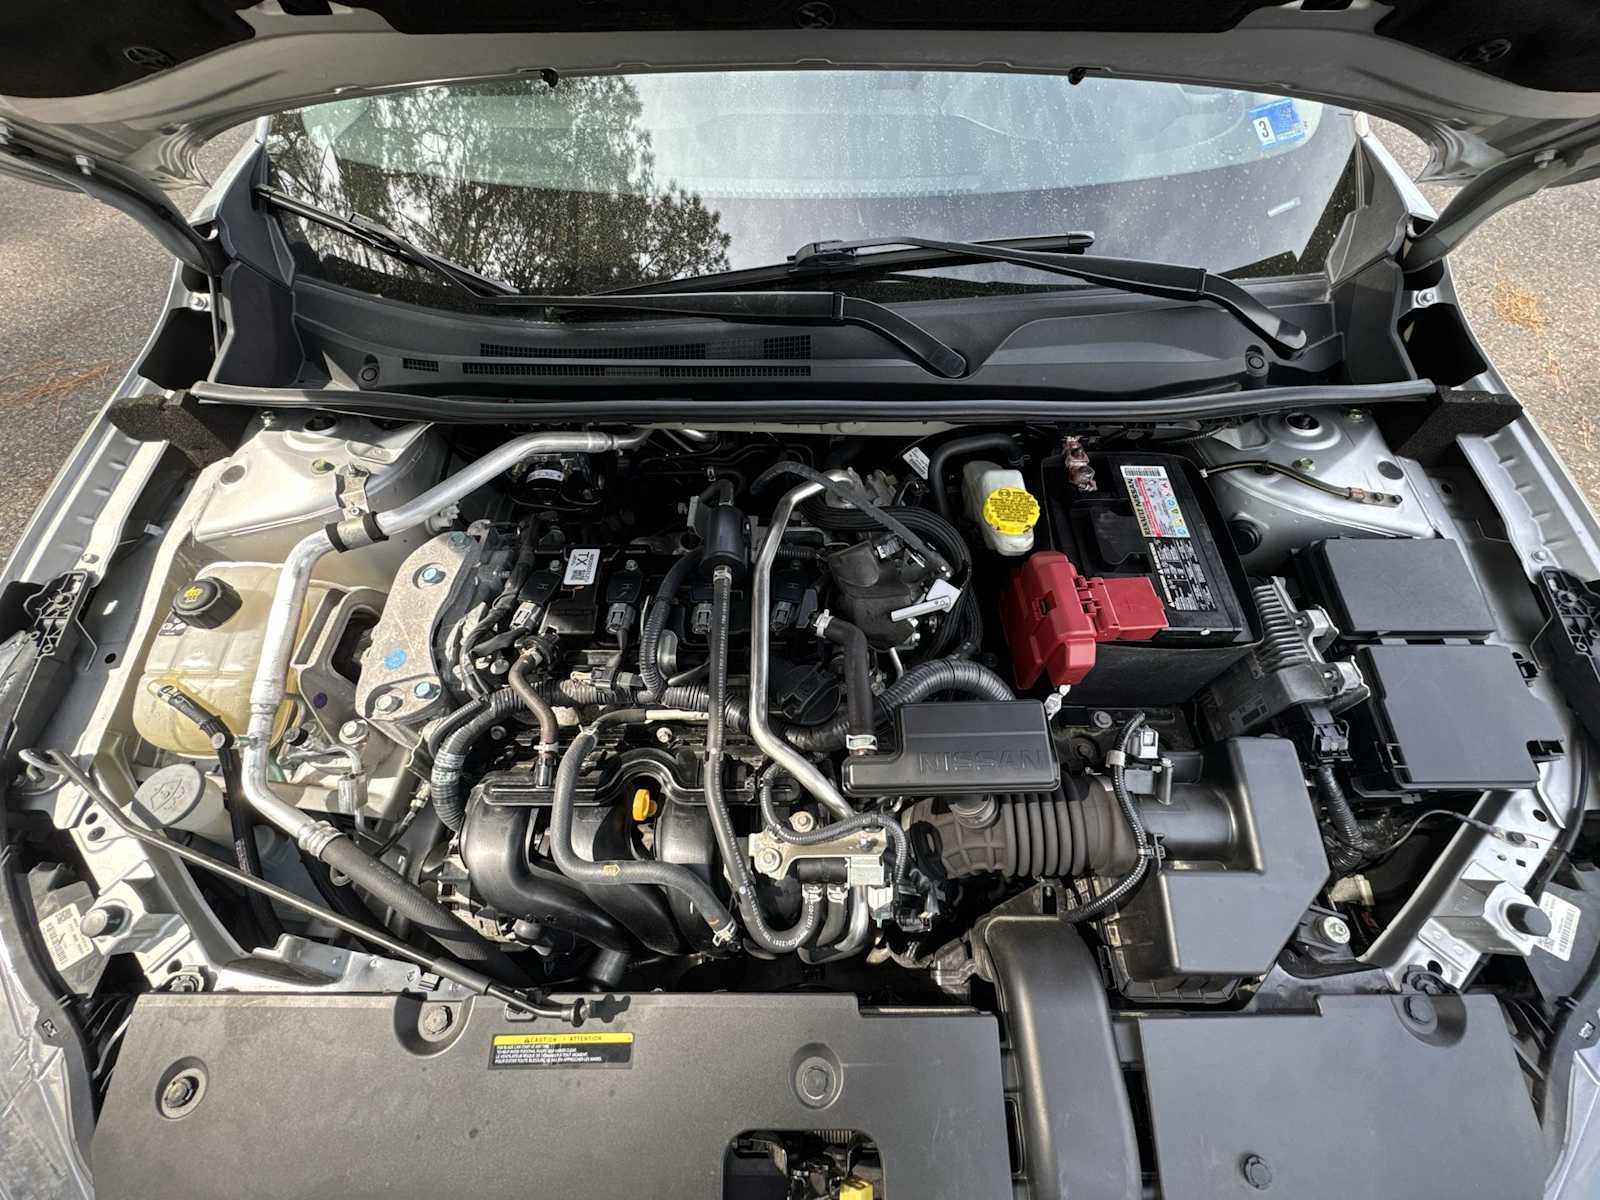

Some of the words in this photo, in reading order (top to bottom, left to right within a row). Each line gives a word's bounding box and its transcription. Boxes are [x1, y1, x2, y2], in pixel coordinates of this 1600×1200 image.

[1258, 120, 1269, 138] 3
[575, 551, 590, 566] TX
[919, 751, 1041, 772] NISSAN
